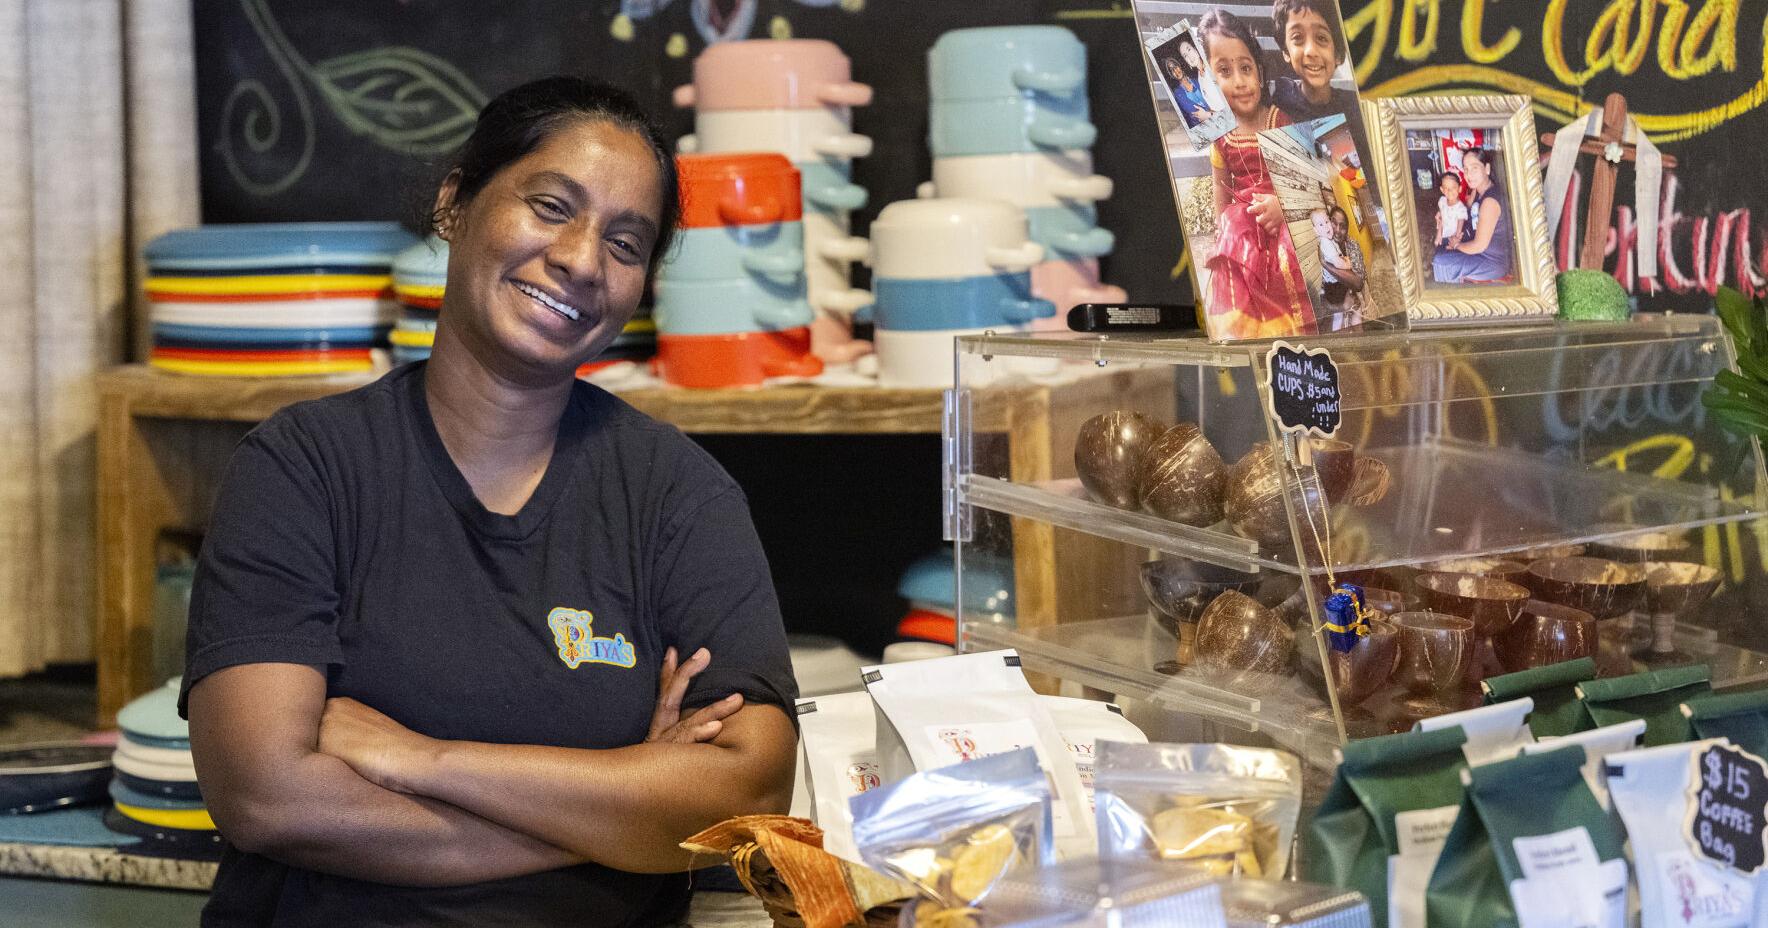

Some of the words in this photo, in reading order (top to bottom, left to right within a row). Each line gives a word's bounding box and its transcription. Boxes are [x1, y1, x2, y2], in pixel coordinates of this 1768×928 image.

[1278, 355, 1301, 374] Hand
[1304, 361, 1331, 381] Made
[1278, 373, 1304, 400] CUPS
[1704, 750, 1751, 801] $15
[1700, 820, 1737, 867] Bag
